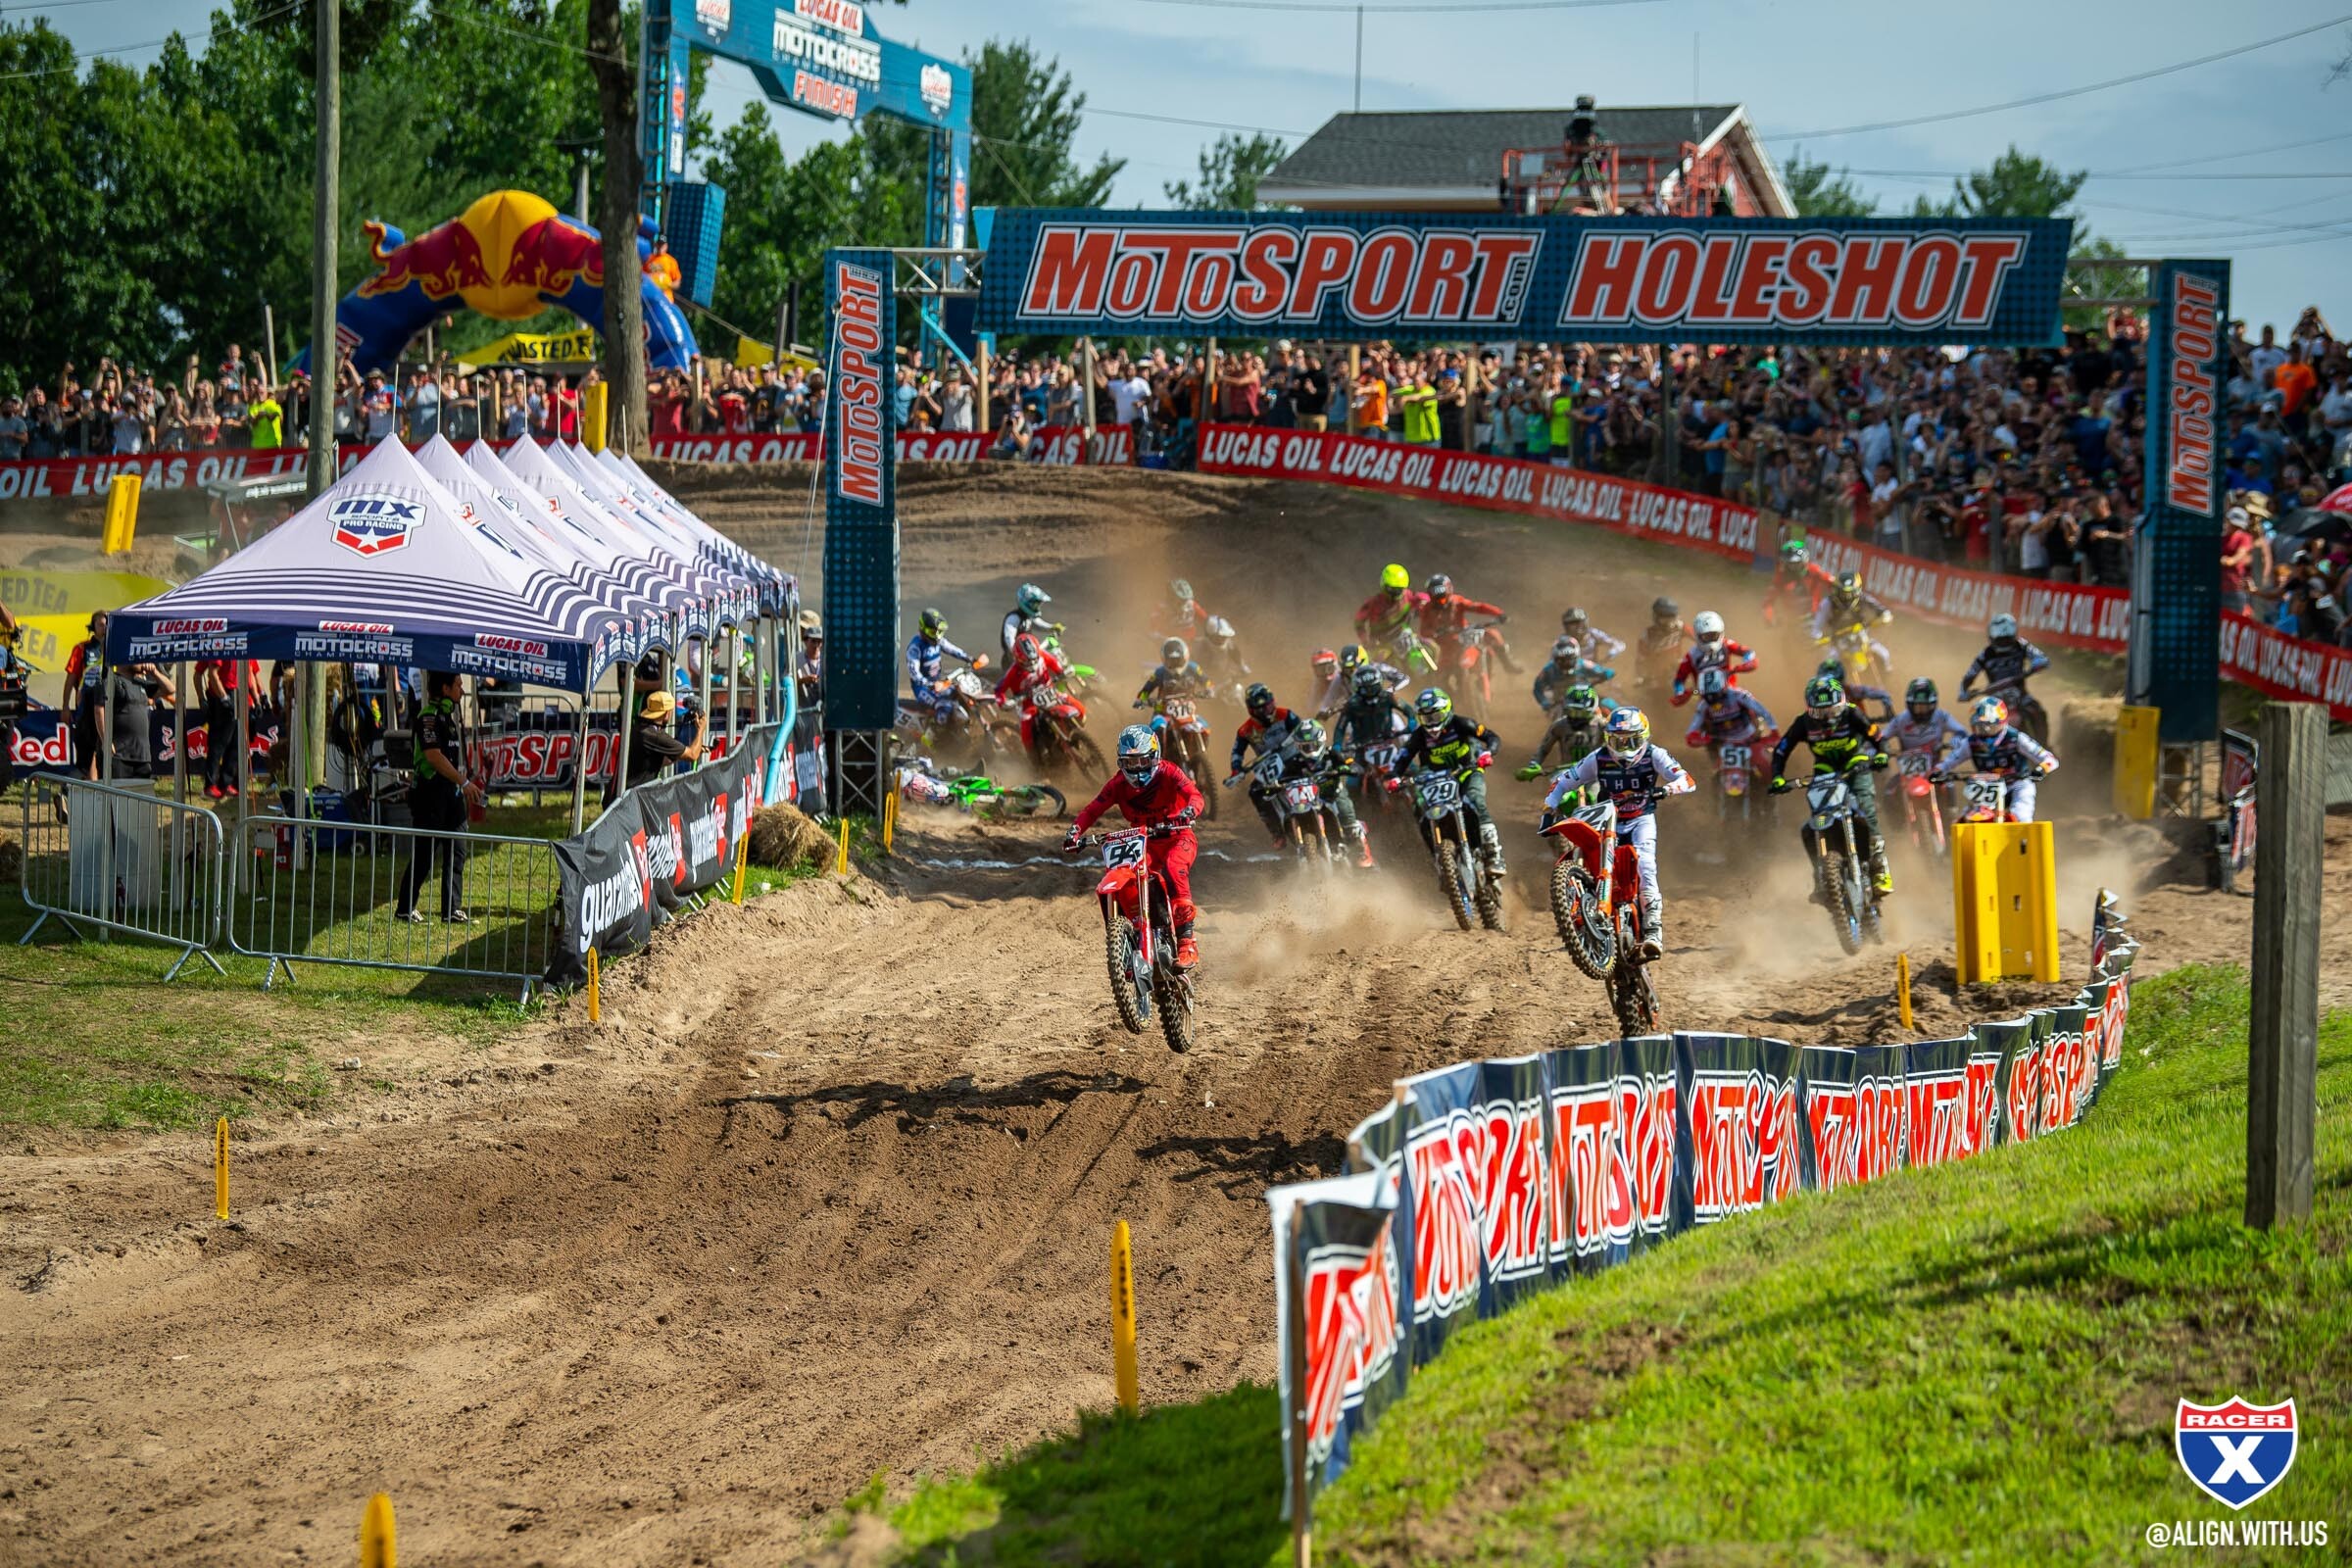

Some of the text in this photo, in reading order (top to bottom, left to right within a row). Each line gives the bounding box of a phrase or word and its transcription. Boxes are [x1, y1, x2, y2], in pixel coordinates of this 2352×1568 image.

[774, 24, 880, 80] MOTOCROSS
[795, 74, 858, 119] FINISH
[1560, 233, 2026, 327] HOLESHOT
[1201, 430, 1323, 470] LUCAS OIL
[1330, 441, 1435, 487] LUCAS OIL
[196, 456, 247, 485] OIL
[1439, 458, 1534, 503] LUCAS OIL
[1541, 472, 1623, 520] LUCAS OIL
[366, 520, 404, 531] RACING
[1628, 489, 1713, 540] LUCAS OIL
[32, 576, 69, 613] TEA
[2020, 587, 2070, 634] LUCAS
[156, 619, 225, 634] LUCAS OIL
[321, 621, 391, 634] LUCAS OIL
[128, 635, 248, 657] MOTOCROSS
[128, 650, 249, 661] CHAMPIONSHIP
[294, 650, 414, 663] CHAMPIONSHIP
[295, 636, 414, 658] MOTOCROSS
[478, 635, 545, 656] LUCAS OIL
[450, 662, 567, 686] CHAMPIONSHIP
[451, 649, 567, 681] MOTOCROSS
[1372, 747, 1395, 766] 17
[1724, 747, 1746, 766] 51
[1427, 783, 1450, 802] 29
[1815, 783, 1839, 811] 7
[1971, 784, 1999, 804] 25
[1109, 840, 1142, 868] 94
